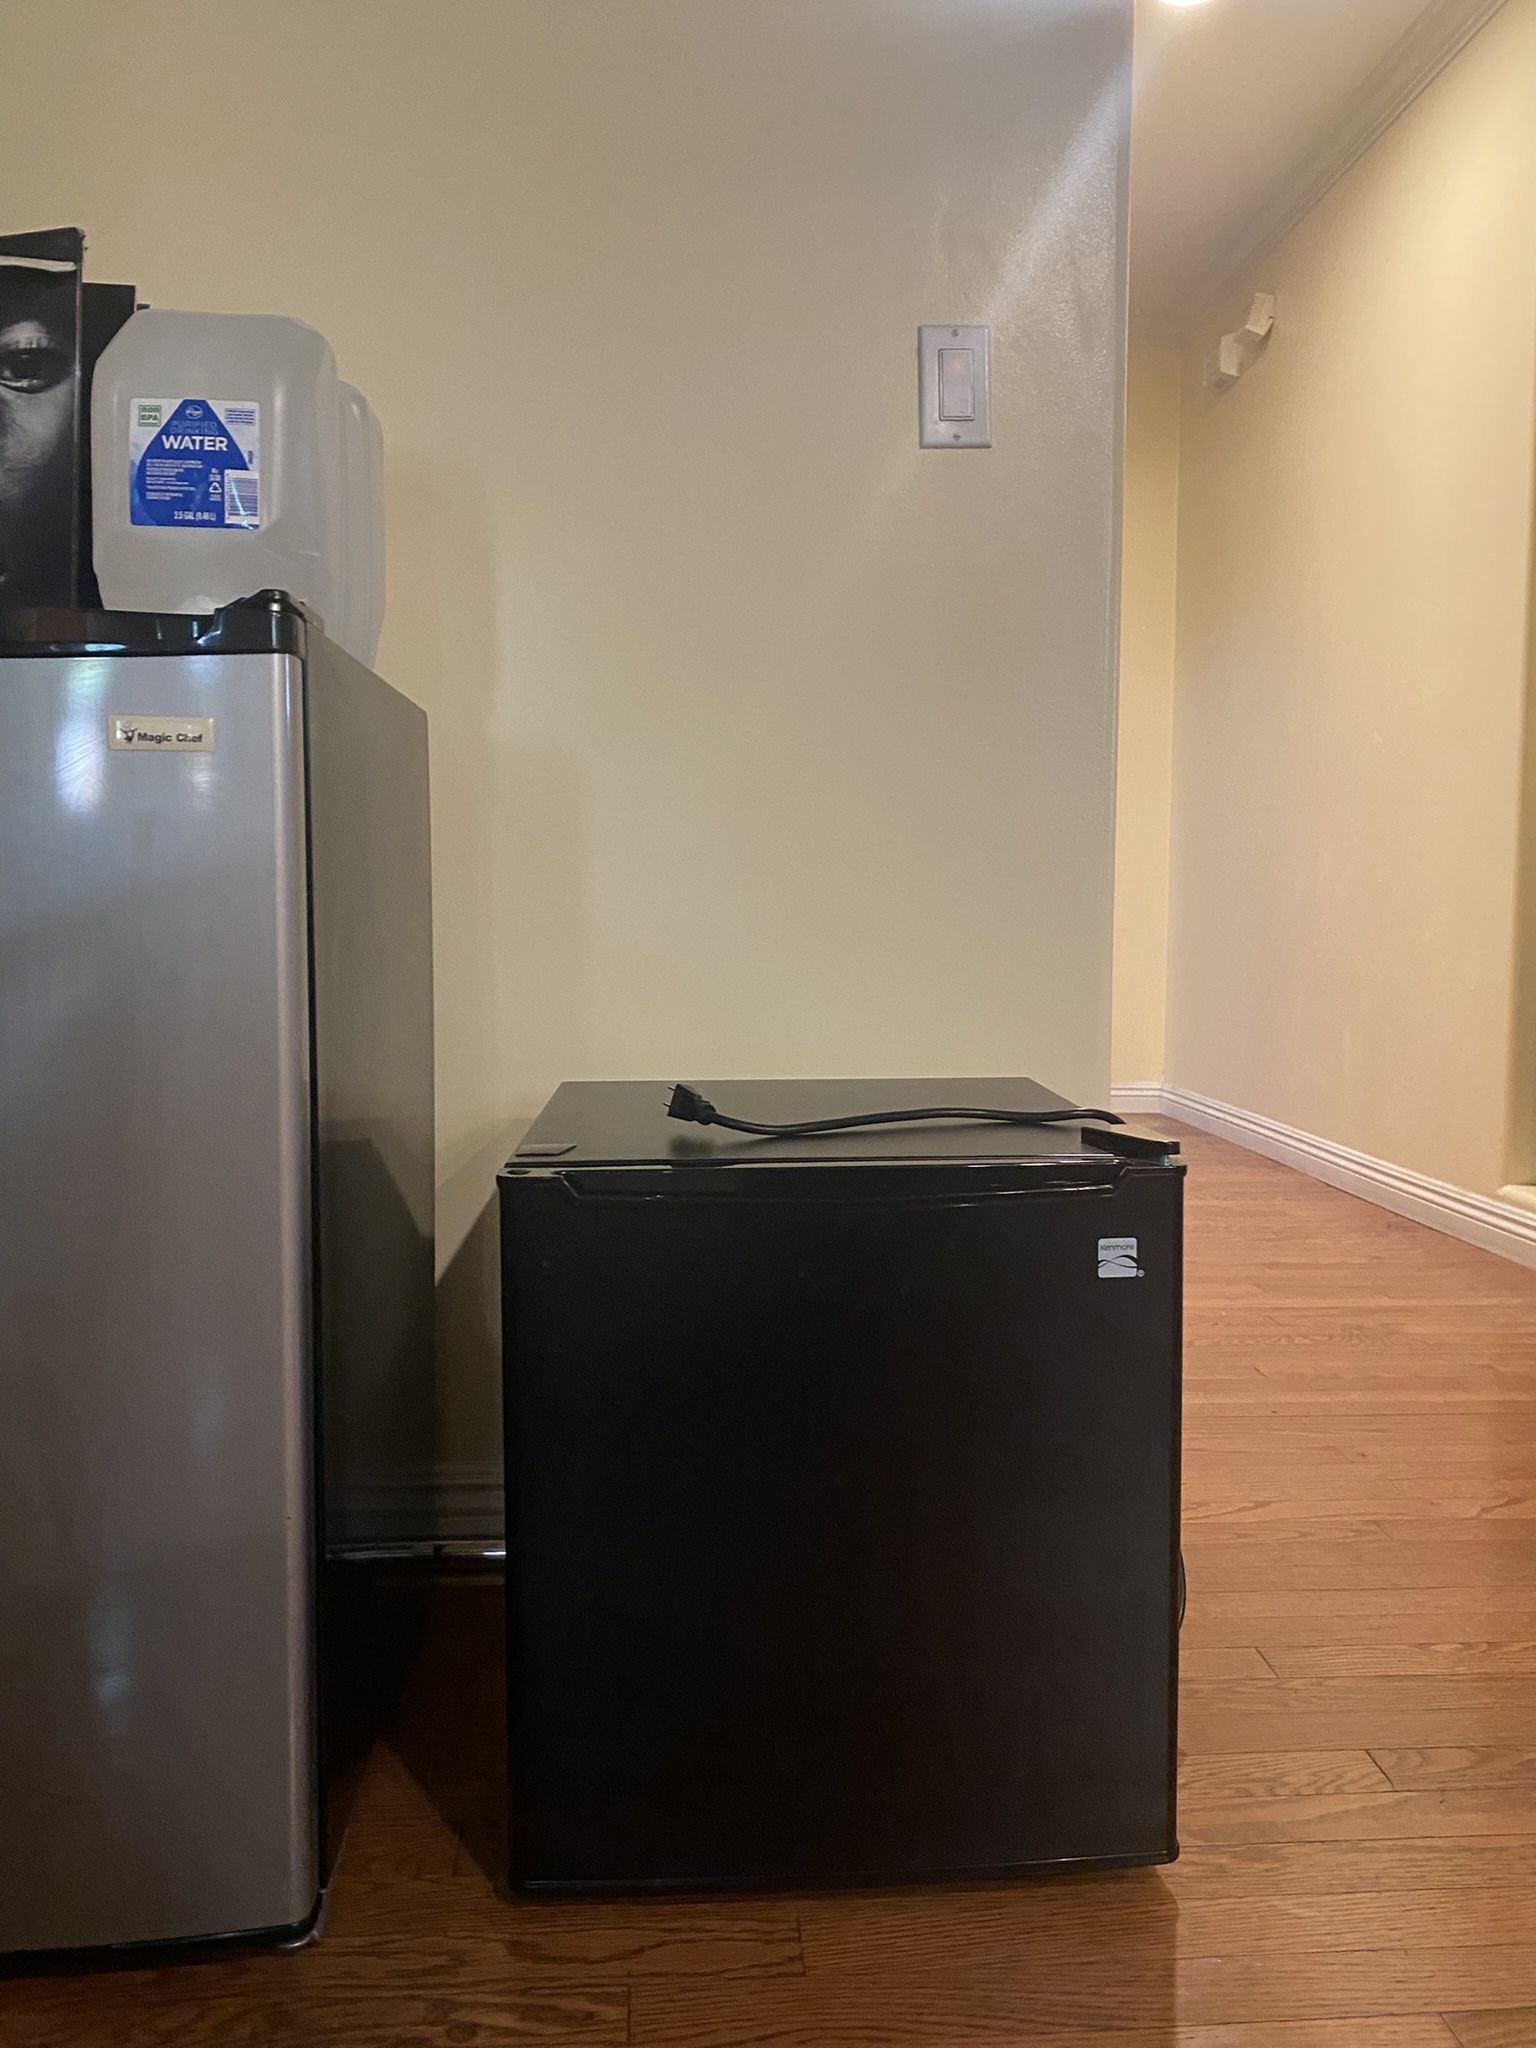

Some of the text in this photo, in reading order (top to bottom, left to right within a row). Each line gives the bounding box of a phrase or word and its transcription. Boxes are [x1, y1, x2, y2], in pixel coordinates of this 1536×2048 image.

[161, 434, 228, 451] WATER
[137, 731, 204, 745] Magic Chef
